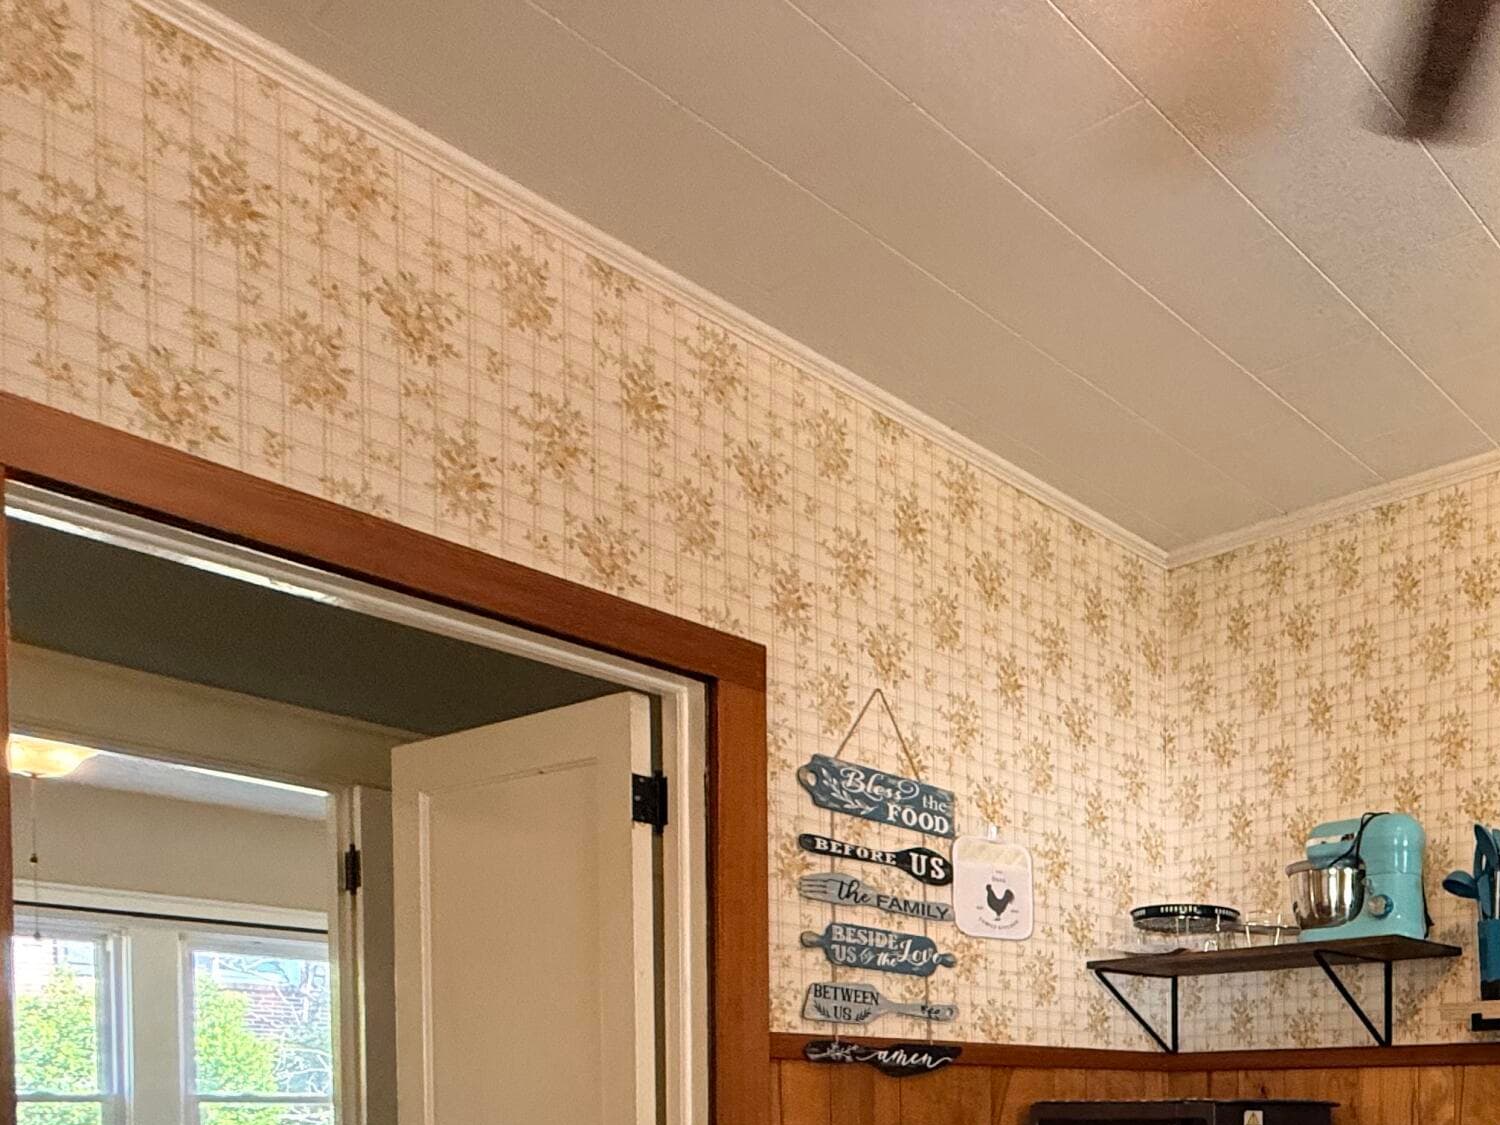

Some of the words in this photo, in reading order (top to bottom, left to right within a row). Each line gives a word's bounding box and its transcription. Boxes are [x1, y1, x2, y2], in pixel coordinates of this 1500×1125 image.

[840, 767, 919, 801] Bless
[922, 794, 948, 813] the
[887, 802, 950, 834] FOOD
[814, 837, 896, 865] BEFORE
[909, 852, 946, 879] US
[835, 880, 872, 904] the
[876, 894, 949, 919] FAMILY
[831, 924, 899, 950] BESIDE
[831, 944, 857, 964] US
[876, 951, 898, 967] the
[897, 939, 941, 966] Love
[813, 983, 880, 1006] BETWEEN
[833, 1005, 852, 1021] US
[856, 1049, 953, 1068] amen
